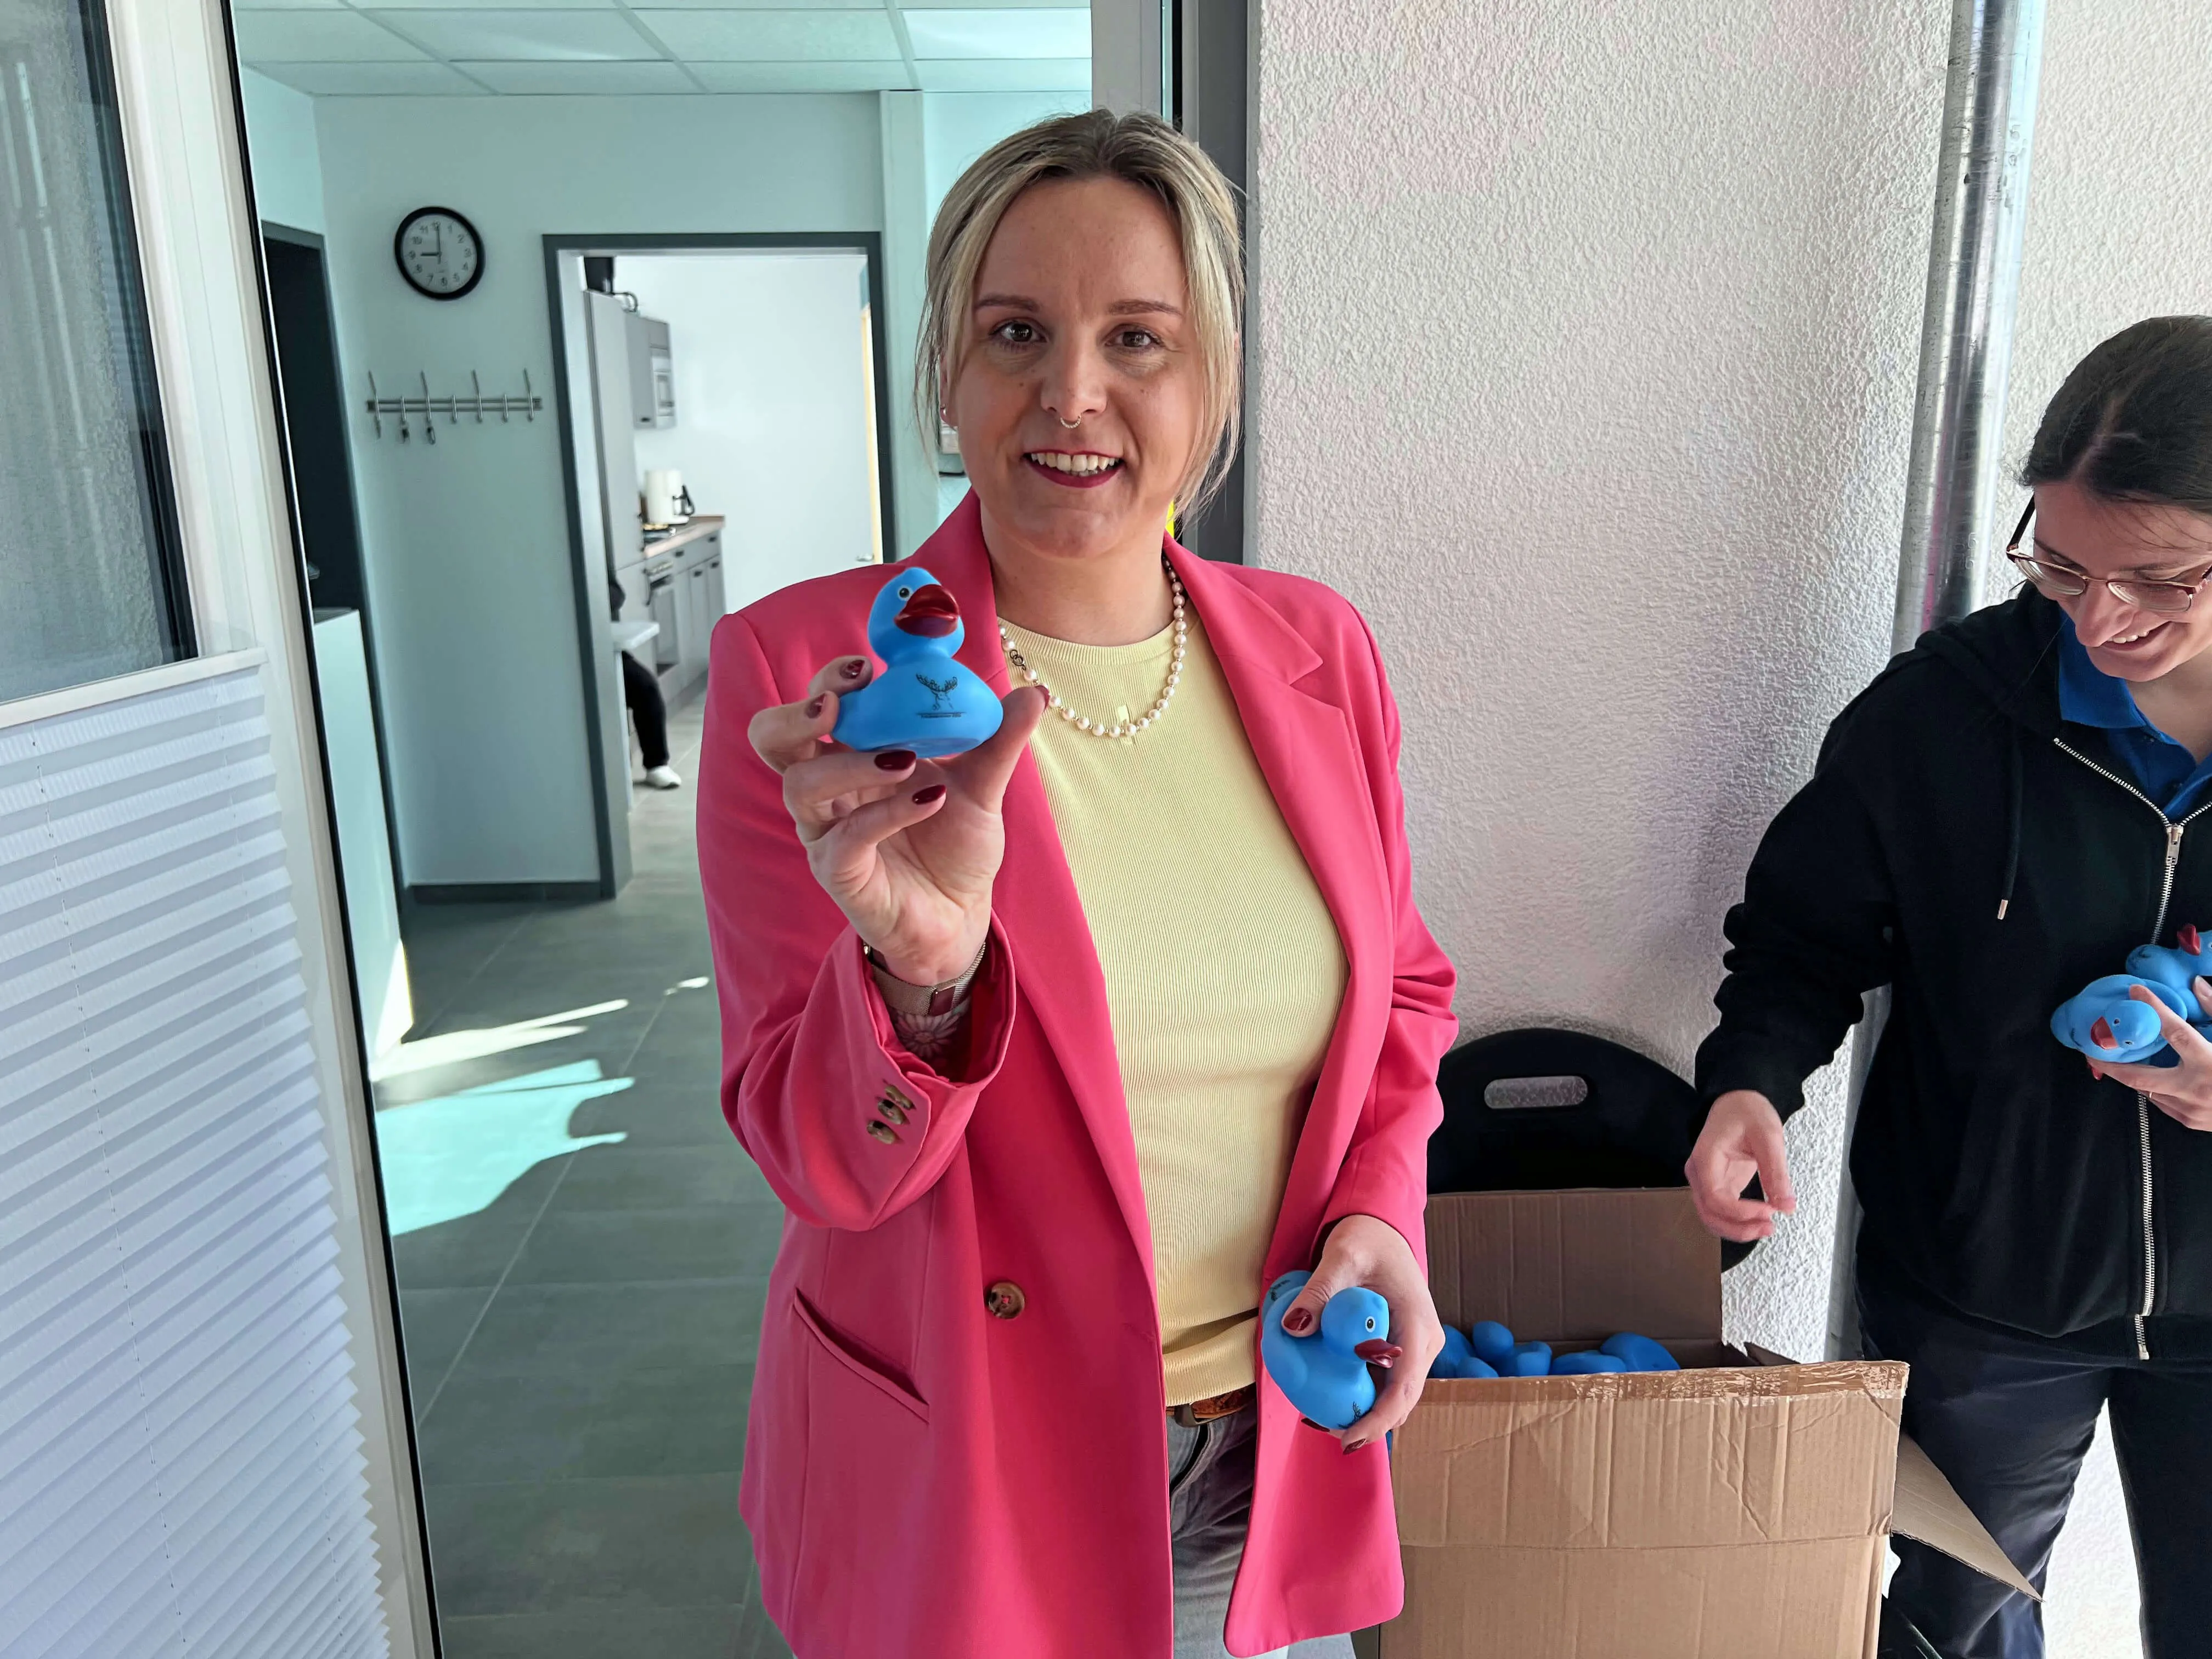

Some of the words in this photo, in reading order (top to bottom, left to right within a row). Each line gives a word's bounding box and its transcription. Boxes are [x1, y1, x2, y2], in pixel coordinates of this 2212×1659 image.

[419, 225, 428, 234] 11
[411, 236, 422, 245] 10
[458, 234, 465, 244] 2
[409, 250, 416, 260] 9
[465, 248, 472, 258] 3
[462, 262, 469, 271] 4
[427, 273, 434, 285] 7
[441, 277, 448, 287] 6
